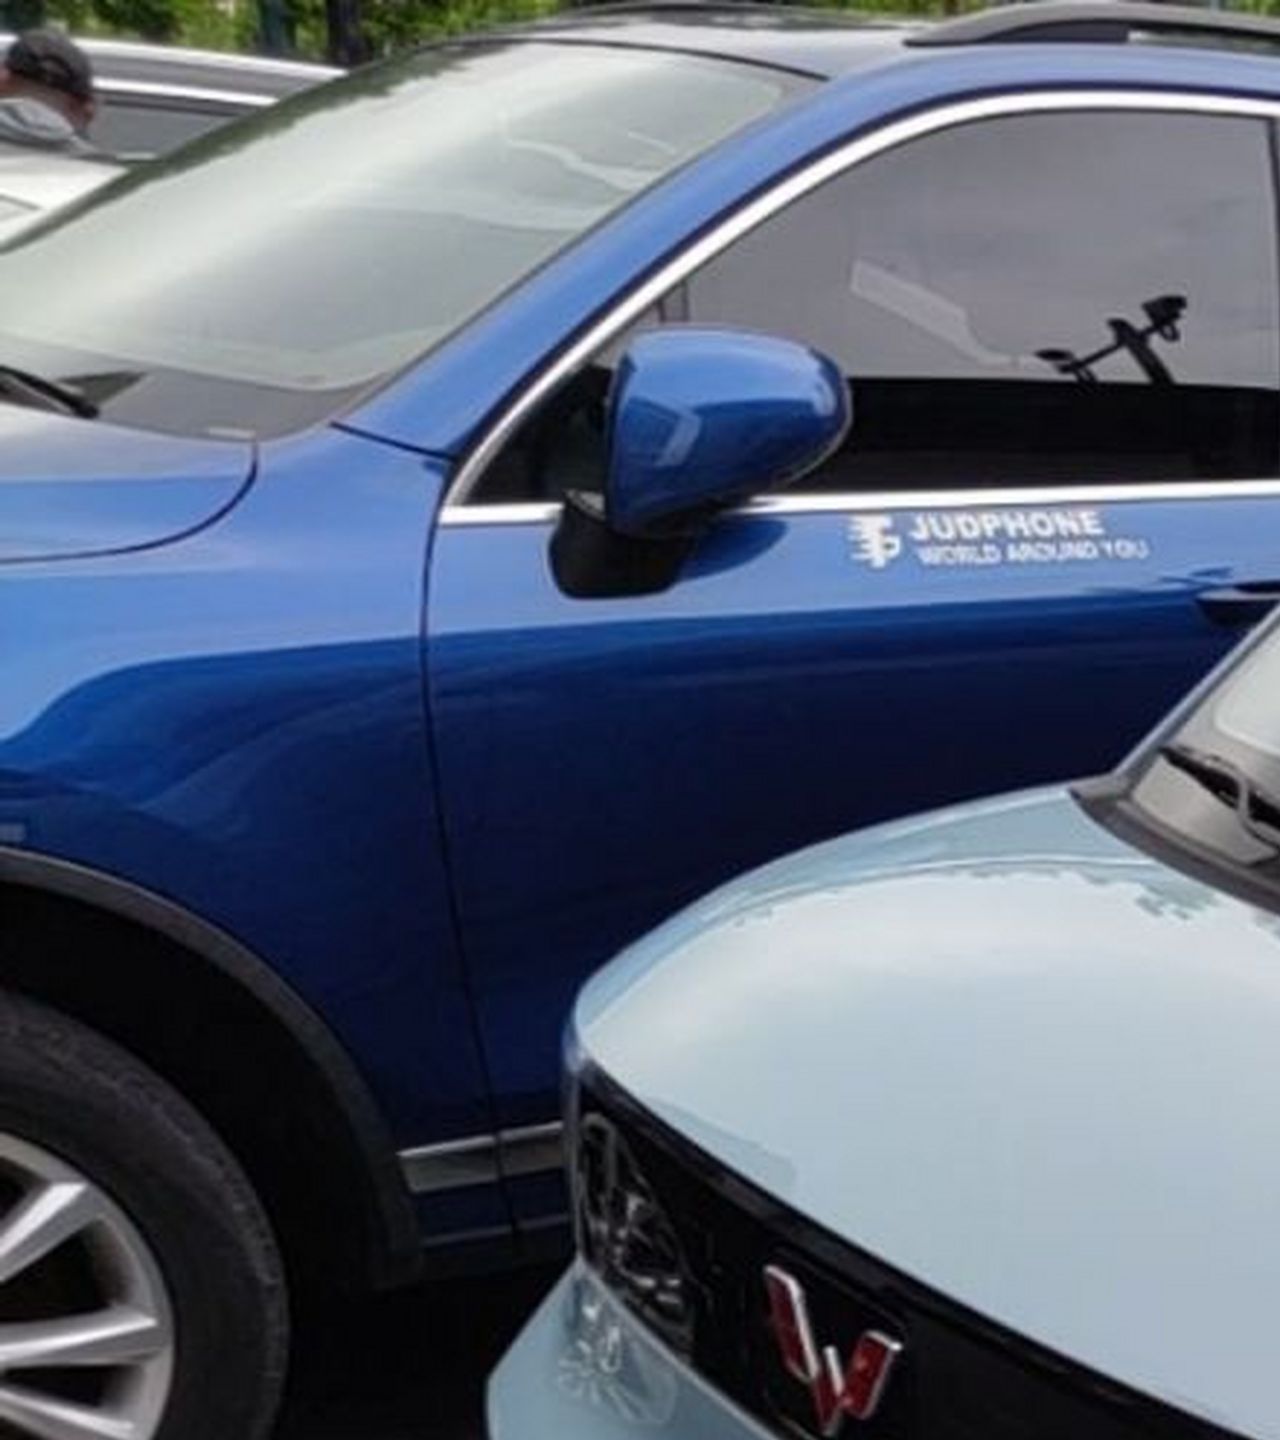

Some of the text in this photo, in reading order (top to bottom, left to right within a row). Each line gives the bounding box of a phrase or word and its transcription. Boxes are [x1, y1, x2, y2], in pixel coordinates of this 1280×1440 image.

[910, 511, 1103, 540] JUDPHONE
[1006, 542, 1099, 562] AROUND
[1101, 538, 1149, 560] YOU
